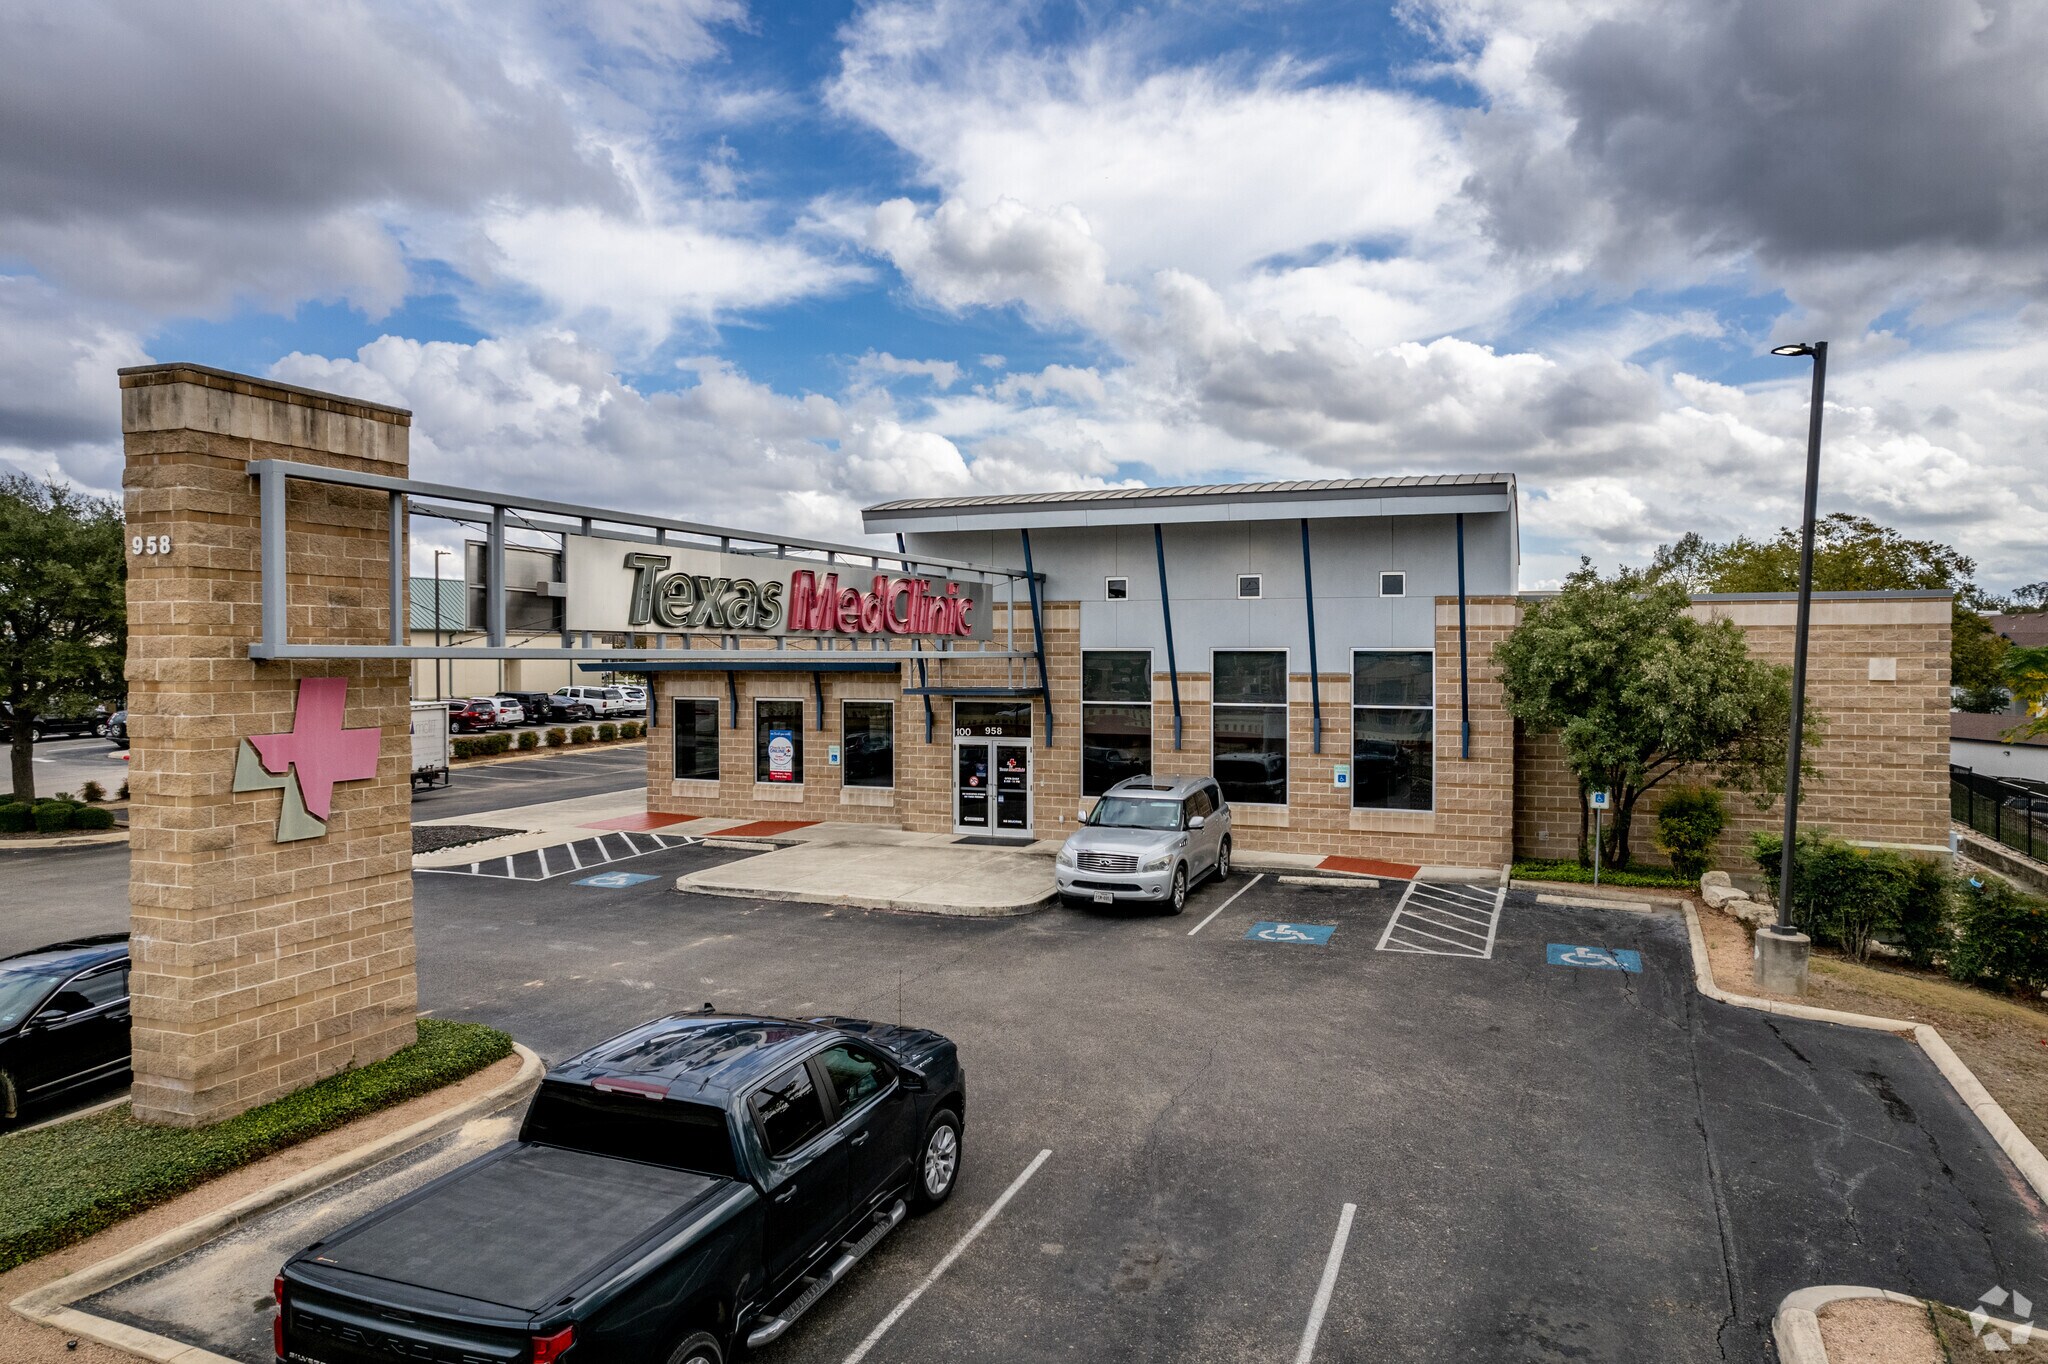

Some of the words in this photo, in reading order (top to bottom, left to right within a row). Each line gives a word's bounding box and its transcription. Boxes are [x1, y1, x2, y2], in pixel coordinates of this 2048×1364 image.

[132, 535, 170, 555] 958
[624, 552, 783, 629] Texas
[788, 569, 973, 637] MedClinic
[956, 728, 971, 736] 100
[985, 727, 1002, 735] 958
[296, 1314, 508, 1364] CHEVROLE
